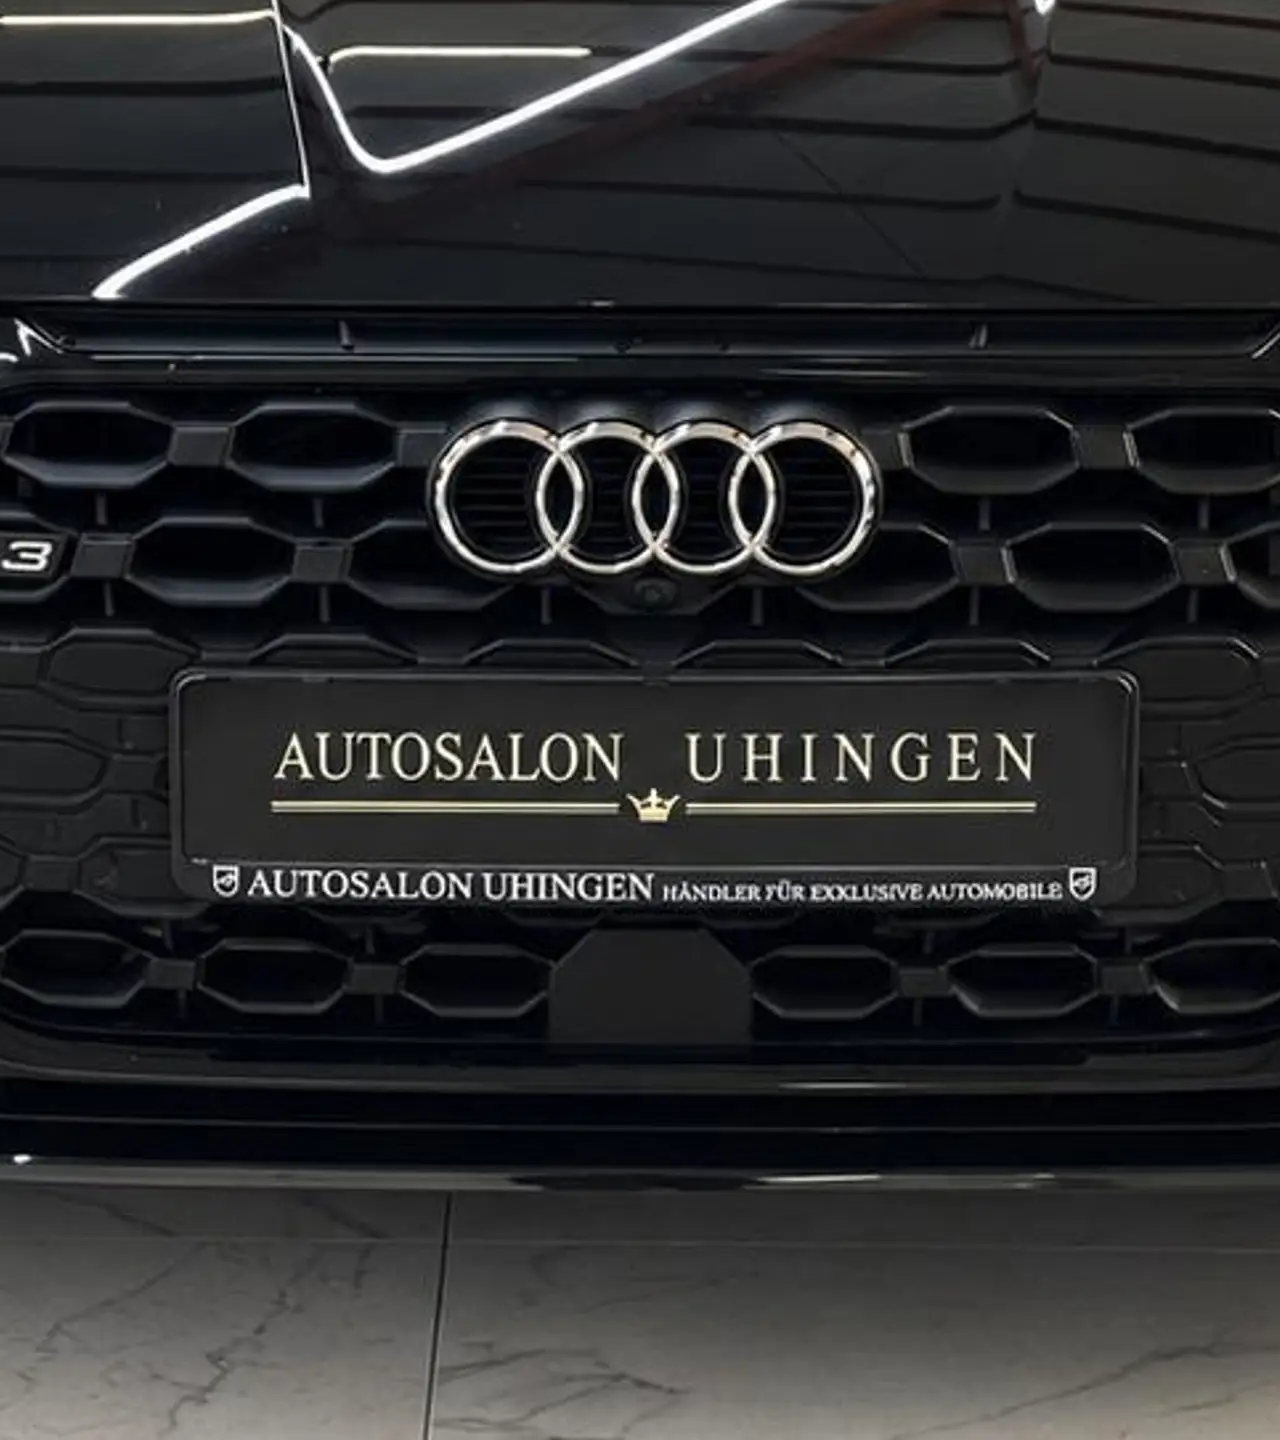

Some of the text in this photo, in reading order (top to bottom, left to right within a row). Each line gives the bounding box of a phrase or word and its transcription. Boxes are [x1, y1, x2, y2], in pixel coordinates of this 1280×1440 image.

[1, 540, 53, 572] 3
[273, 731, 1037, 783] AUTOSALON UHINGEN
[247, 869, 473, 900] AUTOSALON
[481, 871, 655, 902] UHINGEN
[662, 880, 761, 903] HÄNDLER
[764, 878, 805, 903] FÜR
[925, 881, 1063, 903] AUTOMOBILE
